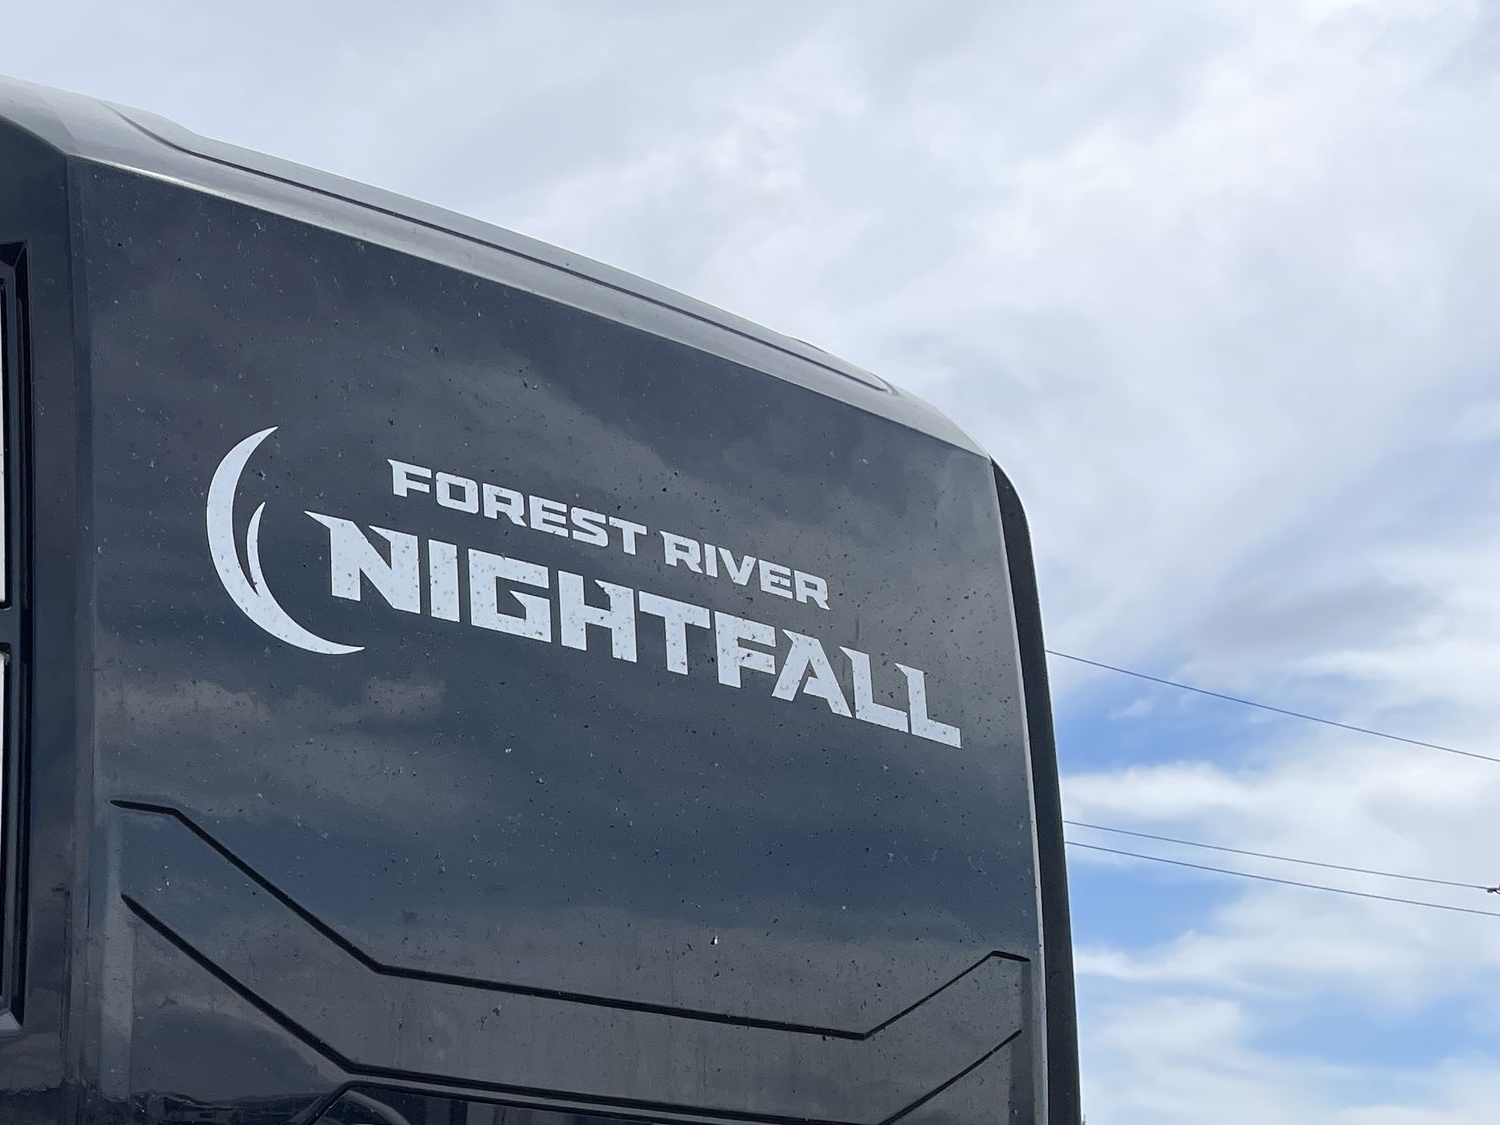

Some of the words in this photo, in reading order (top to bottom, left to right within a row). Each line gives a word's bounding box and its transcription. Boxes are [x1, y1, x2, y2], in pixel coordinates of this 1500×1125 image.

[304, 509, 963, 750] NIGHTFALL
[387, 458, 647, 556] FOREST
[660, 529, 831, 611] RIVER
